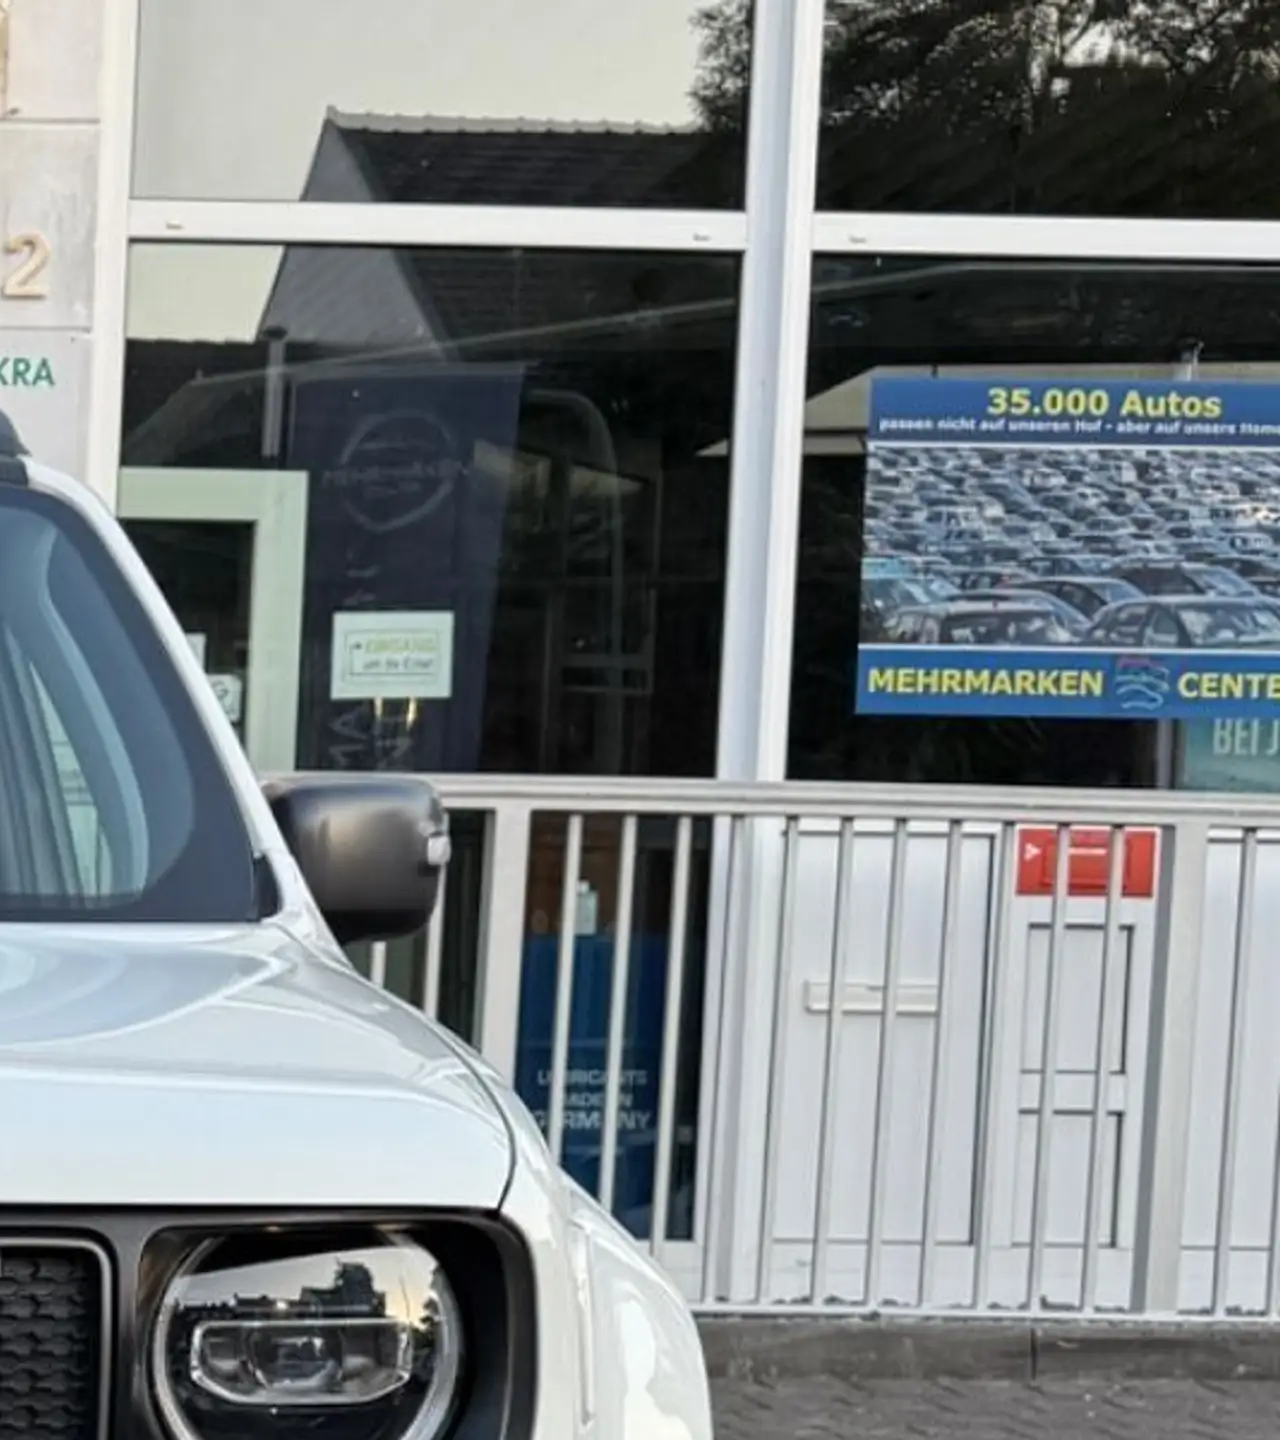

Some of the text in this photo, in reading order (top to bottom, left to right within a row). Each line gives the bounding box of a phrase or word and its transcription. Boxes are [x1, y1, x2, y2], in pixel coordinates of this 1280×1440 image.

[987, 387, 1223, 418] 35.000 Autos
[979, 416, 1007, 431] auf
[867, 668, 1105, 697] MEHRMARKEN
